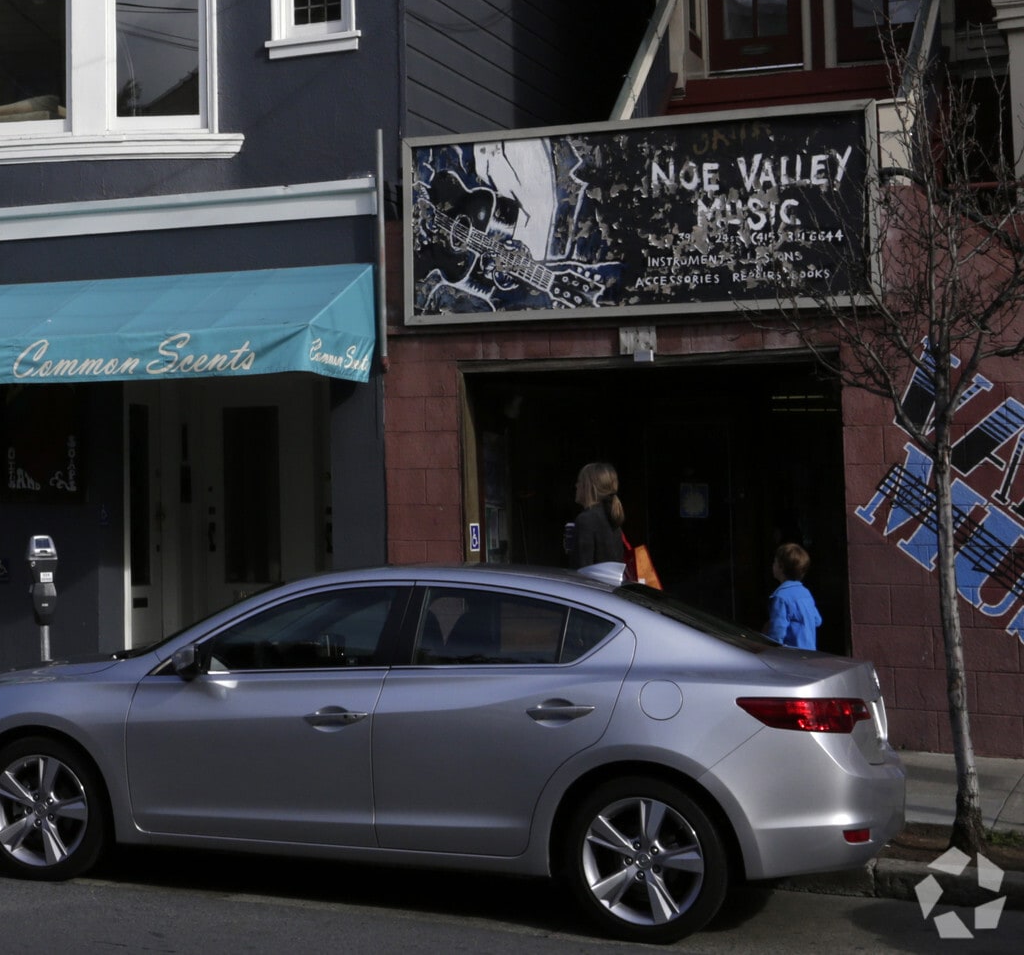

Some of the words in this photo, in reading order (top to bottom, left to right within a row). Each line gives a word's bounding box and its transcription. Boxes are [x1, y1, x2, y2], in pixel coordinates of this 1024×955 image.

[651, 159, 720, 191] NOE
[737, 145, 852, 193] VALLEY
[697, 198, 802, 231] MUSIC
[635, 273, 720, 288] ACCESSORIES
[12, 339, 138, 379] Common
[146, 332, 256, 375] Scents
